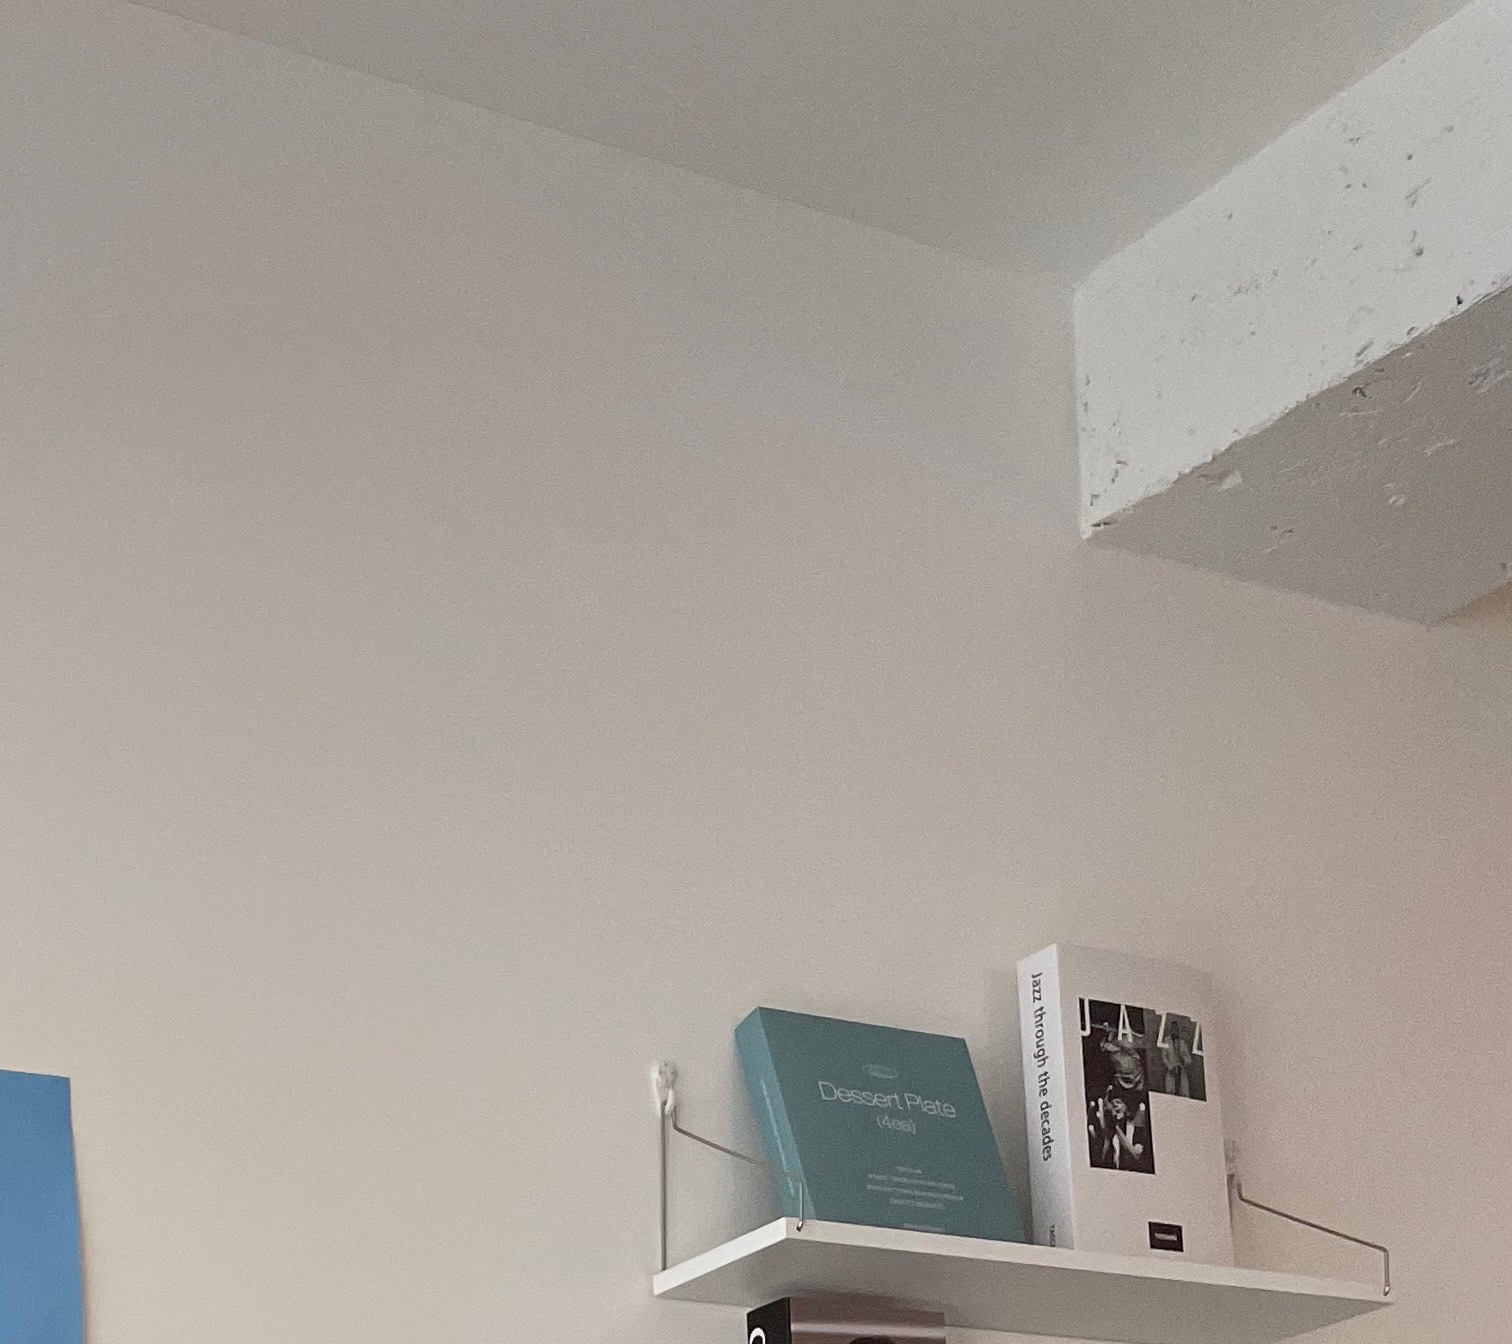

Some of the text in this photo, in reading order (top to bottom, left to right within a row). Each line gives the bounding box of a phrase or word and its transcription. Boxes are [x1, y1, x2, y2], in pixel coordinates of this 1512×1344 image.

[816, 1080, 957, 1119] Dessert Plate
[1031, 972, 1055, 1162] Jazz through the decades
